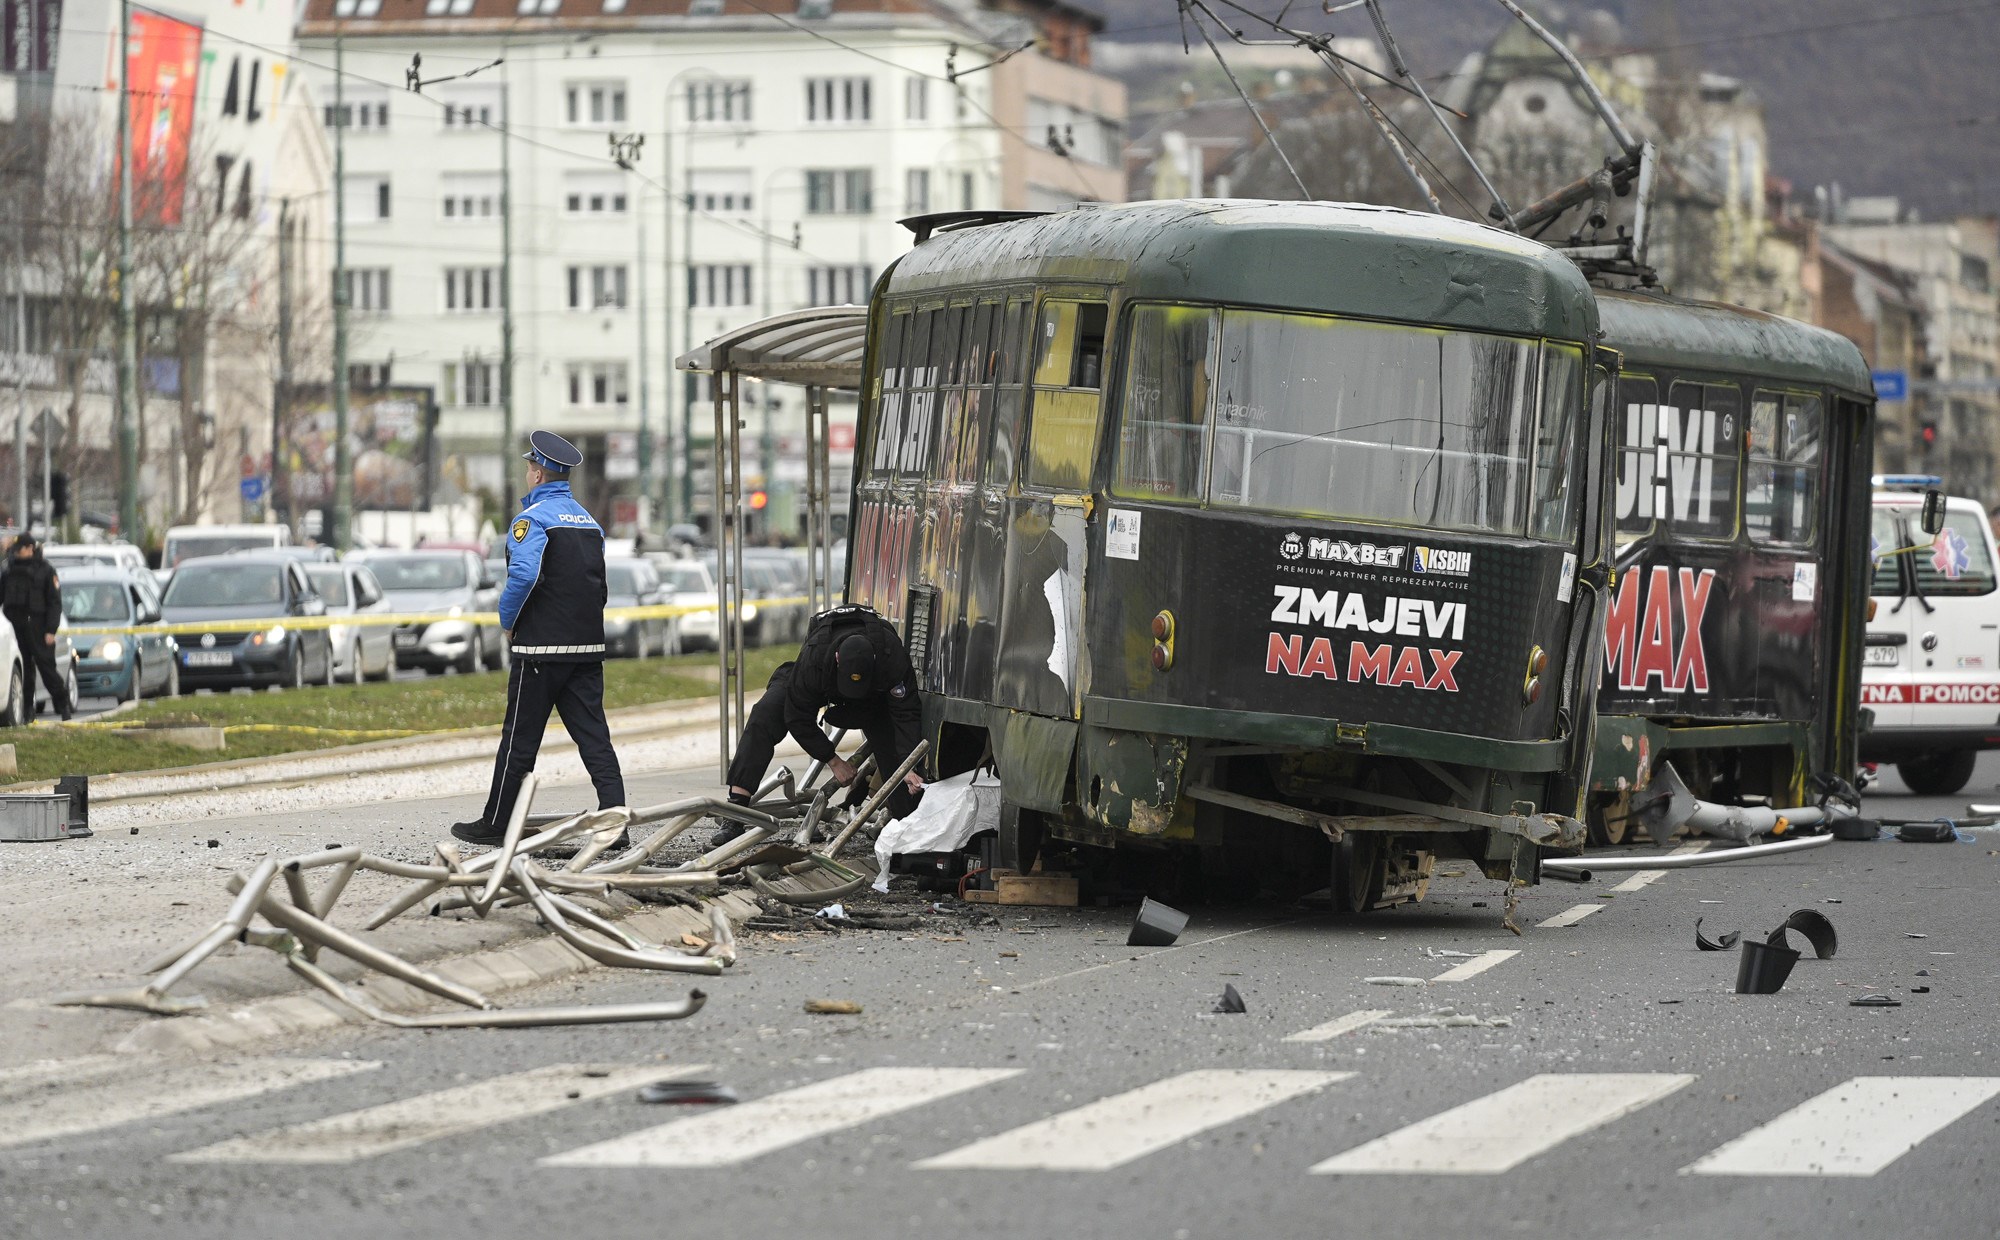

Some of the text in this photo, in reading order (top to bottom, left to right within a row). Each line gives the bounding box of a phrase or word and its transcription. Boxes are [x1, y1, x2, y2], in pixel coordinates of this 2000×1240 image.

[1276, 564, 1469, 591] PREMIUM PARTNER REPREZENTACIJE
[1428, 549, 1472, 572] KSBIH
[1271, 585, 1467, 641] ZMAJEVI
[1602, 565, 1716, 694] MAX
[1266, 632, 1463, 692] NA MAX
[1865, 646, 1896, 662] -679
